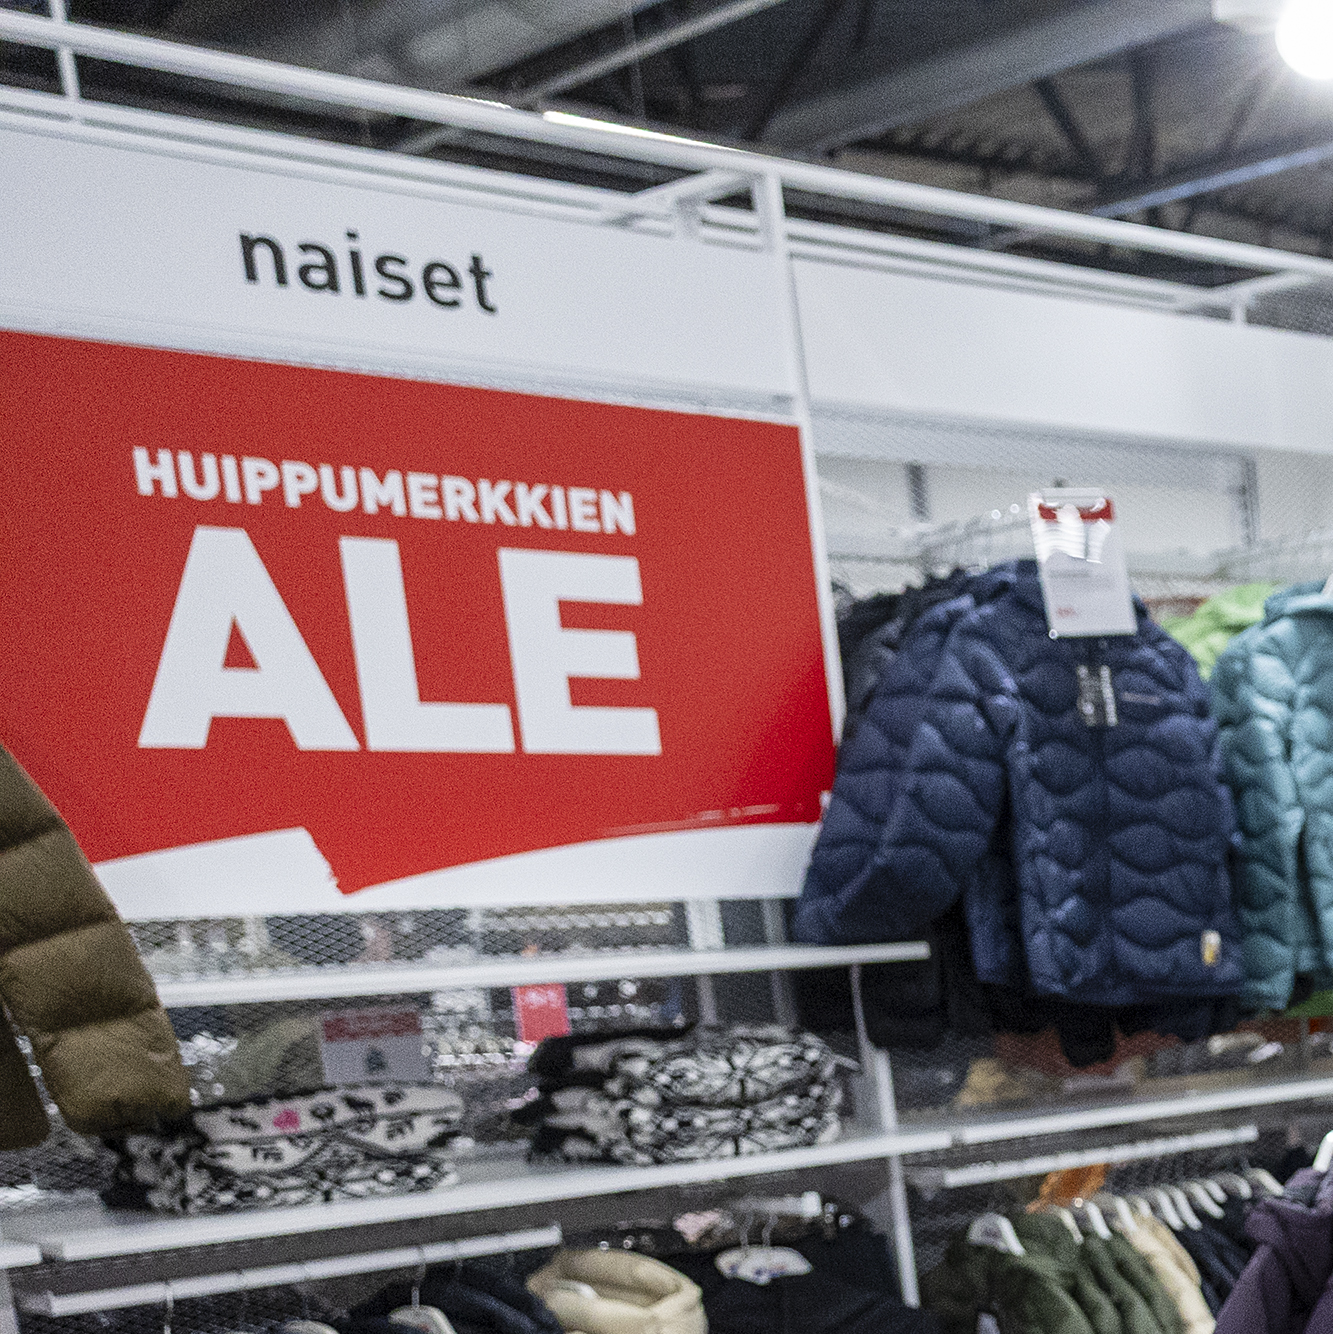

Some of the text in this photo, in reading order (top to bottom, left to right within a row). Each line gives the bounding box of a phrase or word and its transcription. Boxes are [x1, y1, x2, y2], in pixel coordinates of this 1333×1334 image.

[239, 229, 499, 315] naiset
[132, 446, 637, 536] HUIPPUMERKKIEN
[137, 524, 664, 756] ALE
